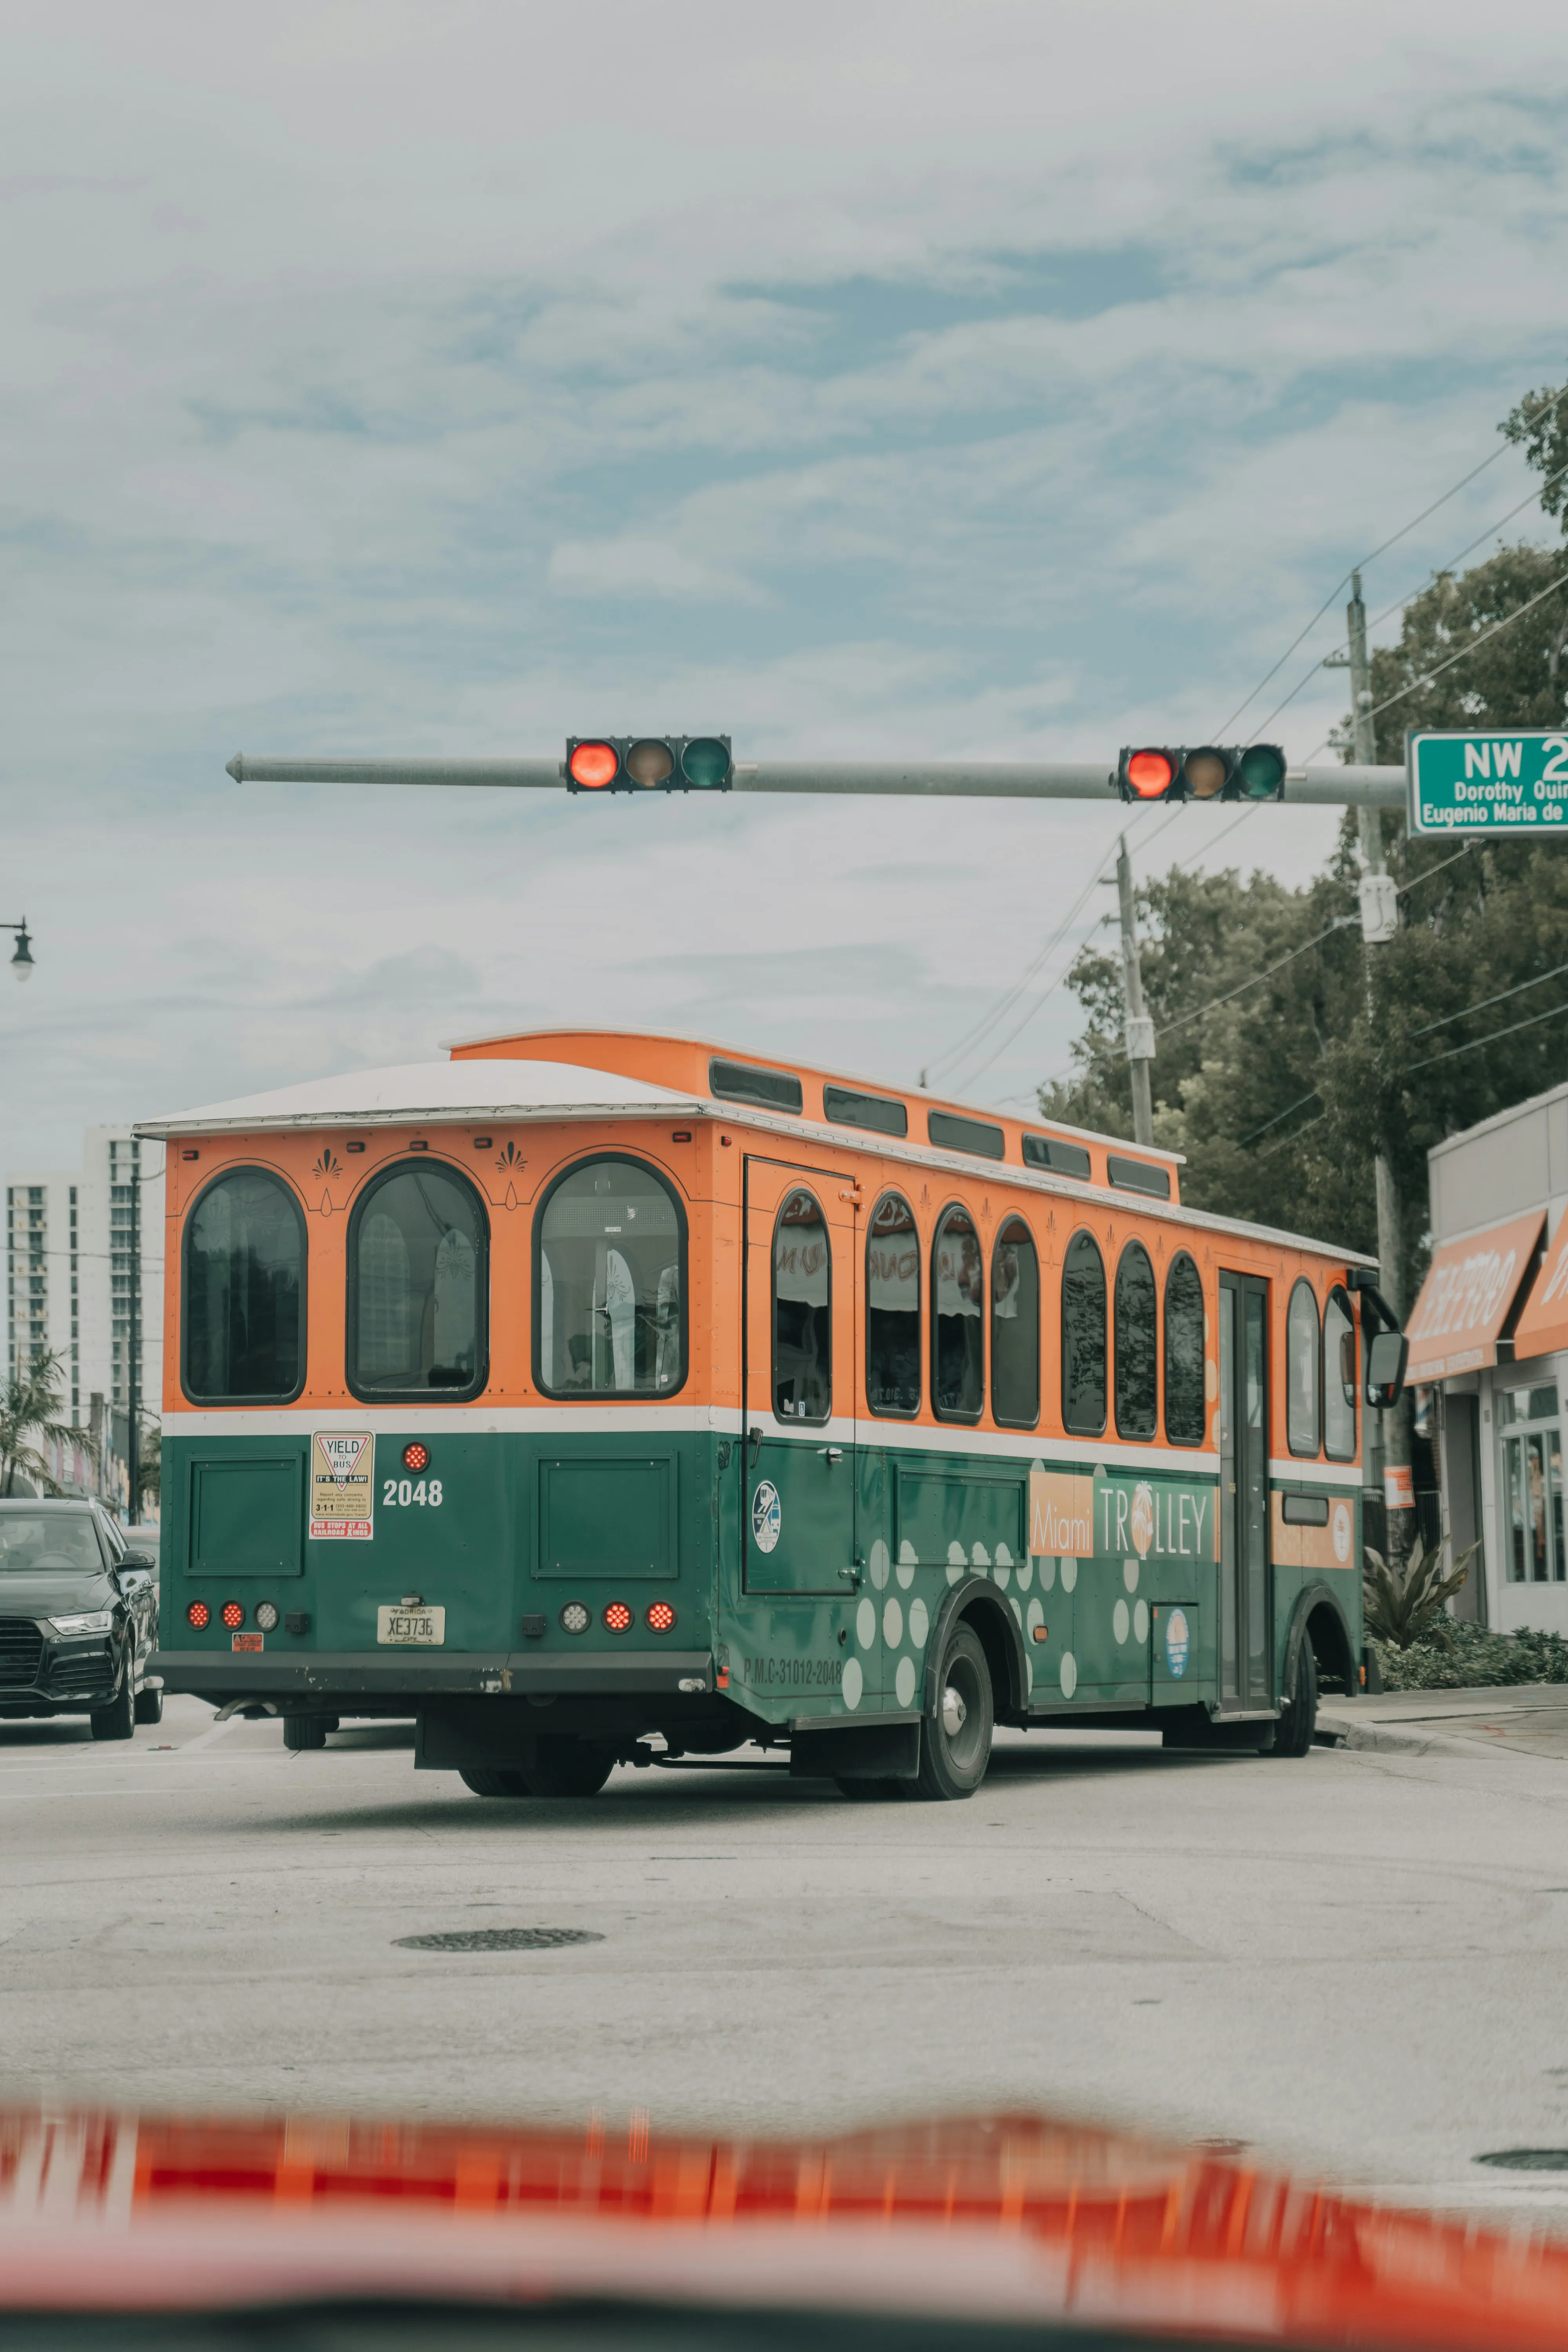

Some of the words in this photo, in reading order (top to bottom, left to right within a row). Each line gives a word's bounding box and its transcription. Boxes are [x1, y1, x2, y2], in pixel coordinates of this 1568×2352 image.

[1465, 742, 1523, 778] NW
[1455, 781, 1524, 804] Dorothy
[1423, 802, 1488, 828] Eugenio
[1494, 802, 1537, 822] Maria
[1542, 802, 1563, 821] de
[327, 1441, 359, 1453] YIELD
[383, 1480, 443, 1506] 2048
[1033, 1498, 1089, 1550] Miami
[389, 1617, 433, 1635] XE3736
[744, 1658, 842, 1685] P.M.C-31012-2048
